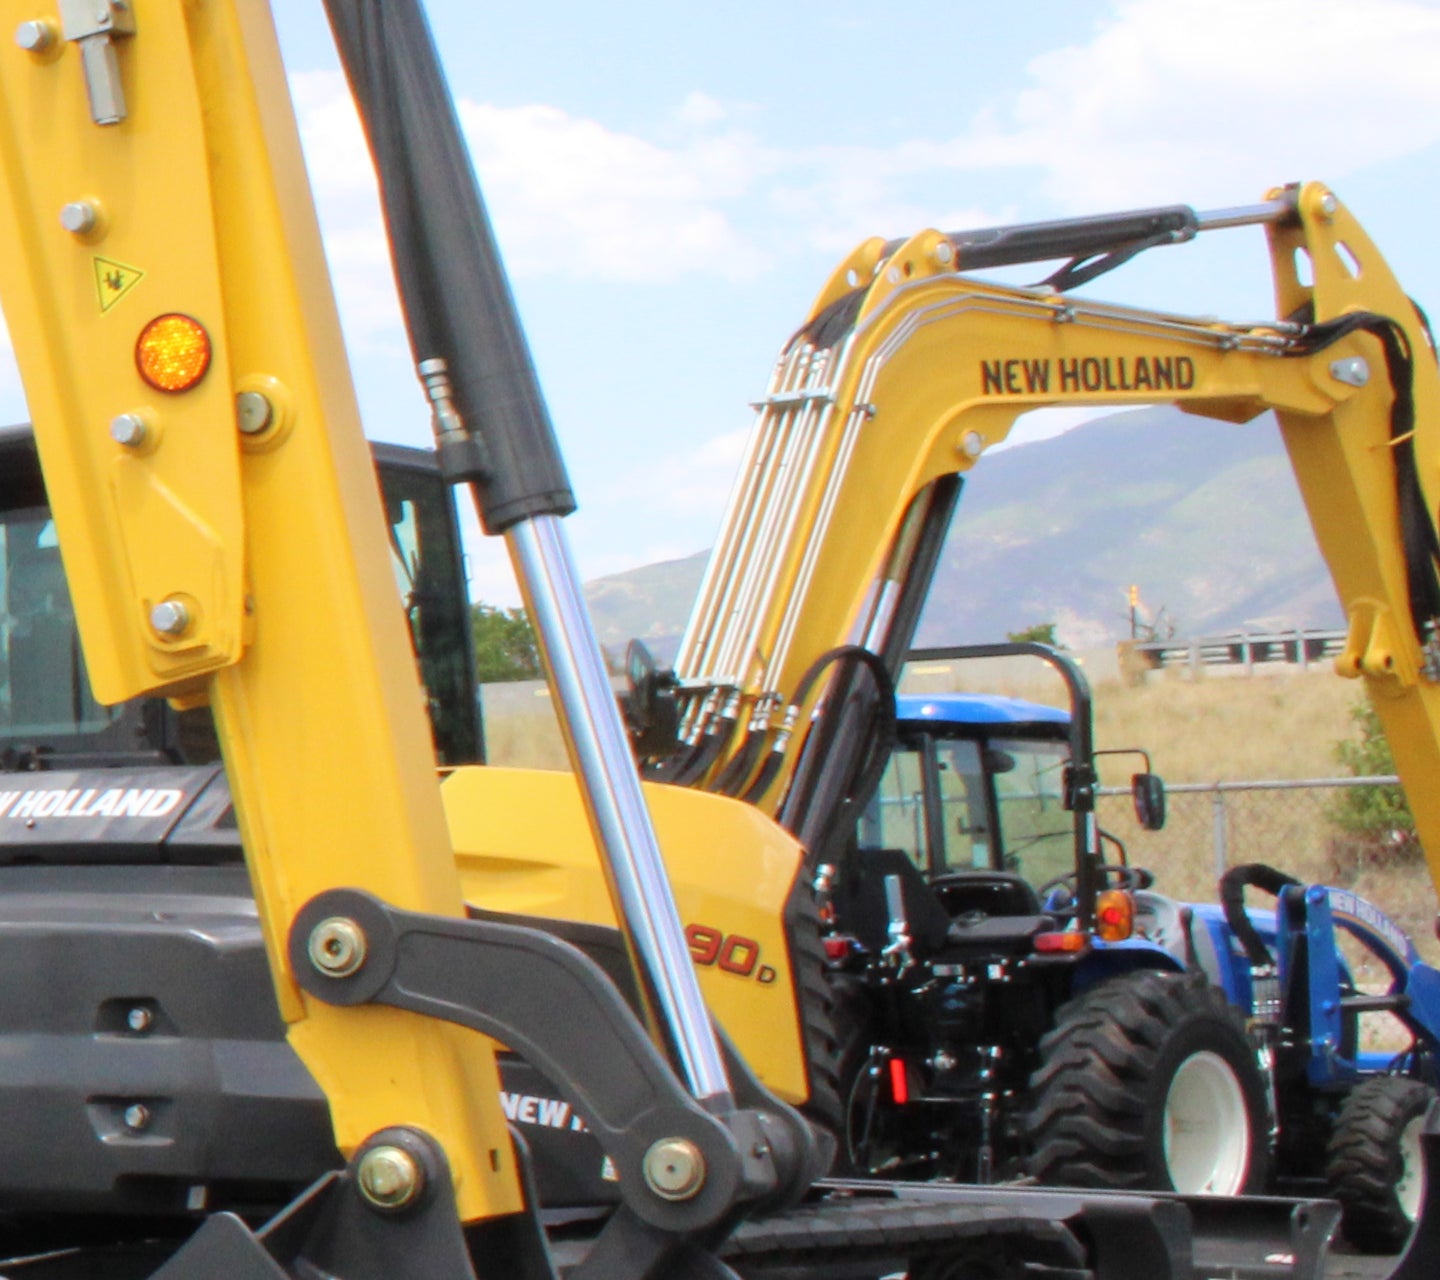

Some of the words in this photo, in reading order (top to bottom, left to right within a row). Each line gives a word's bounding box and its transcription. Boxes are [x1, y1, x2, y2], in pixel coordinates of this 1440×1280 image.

[981, 359, 1049, 395] NEW
[1059, 356, 1194, 392] HOLLAND
[7, 787, 186, 818] HOLLAND
[498, 1090, 571, 1132] NEW
